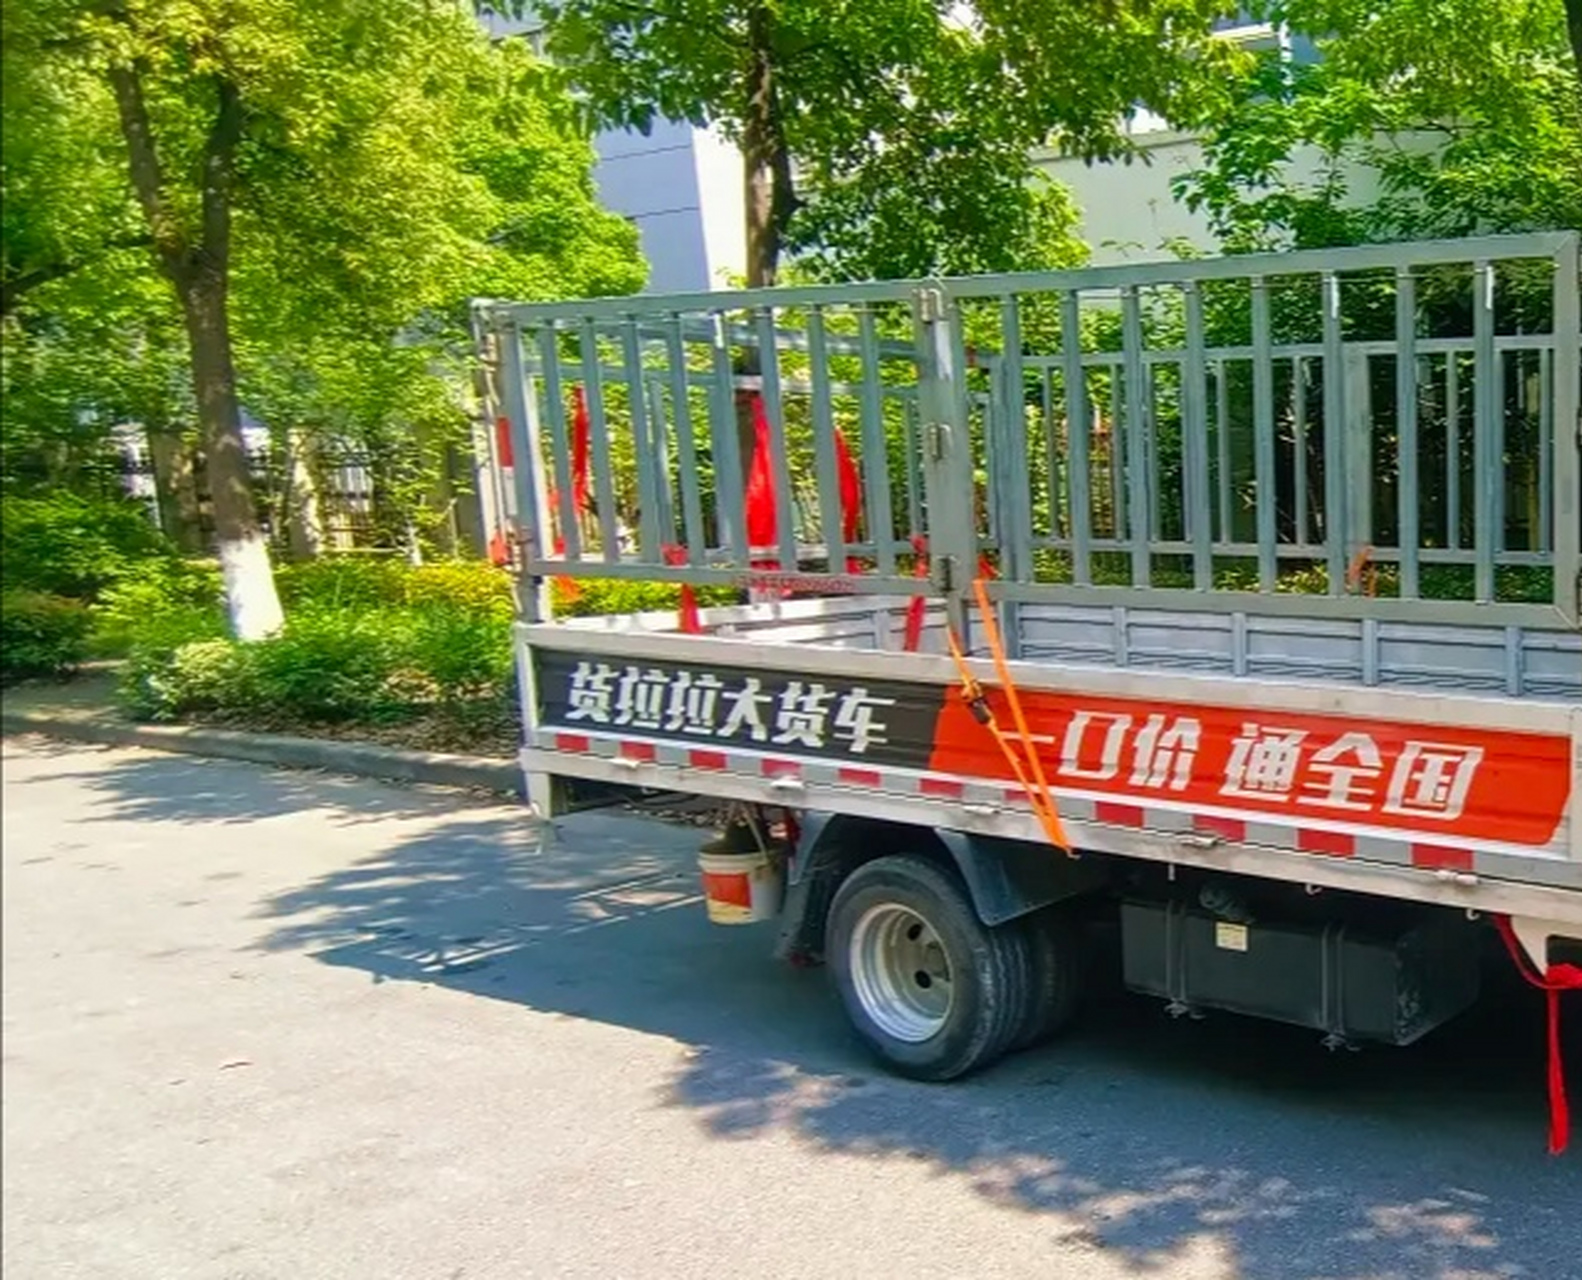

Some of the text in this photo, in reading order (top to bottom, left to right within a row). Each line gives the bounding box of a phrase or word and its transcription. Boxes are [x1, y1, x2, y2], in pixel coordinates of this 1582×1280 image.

[565, 661, 1484, 820] 货拉拉大货车 一口价 通全国
